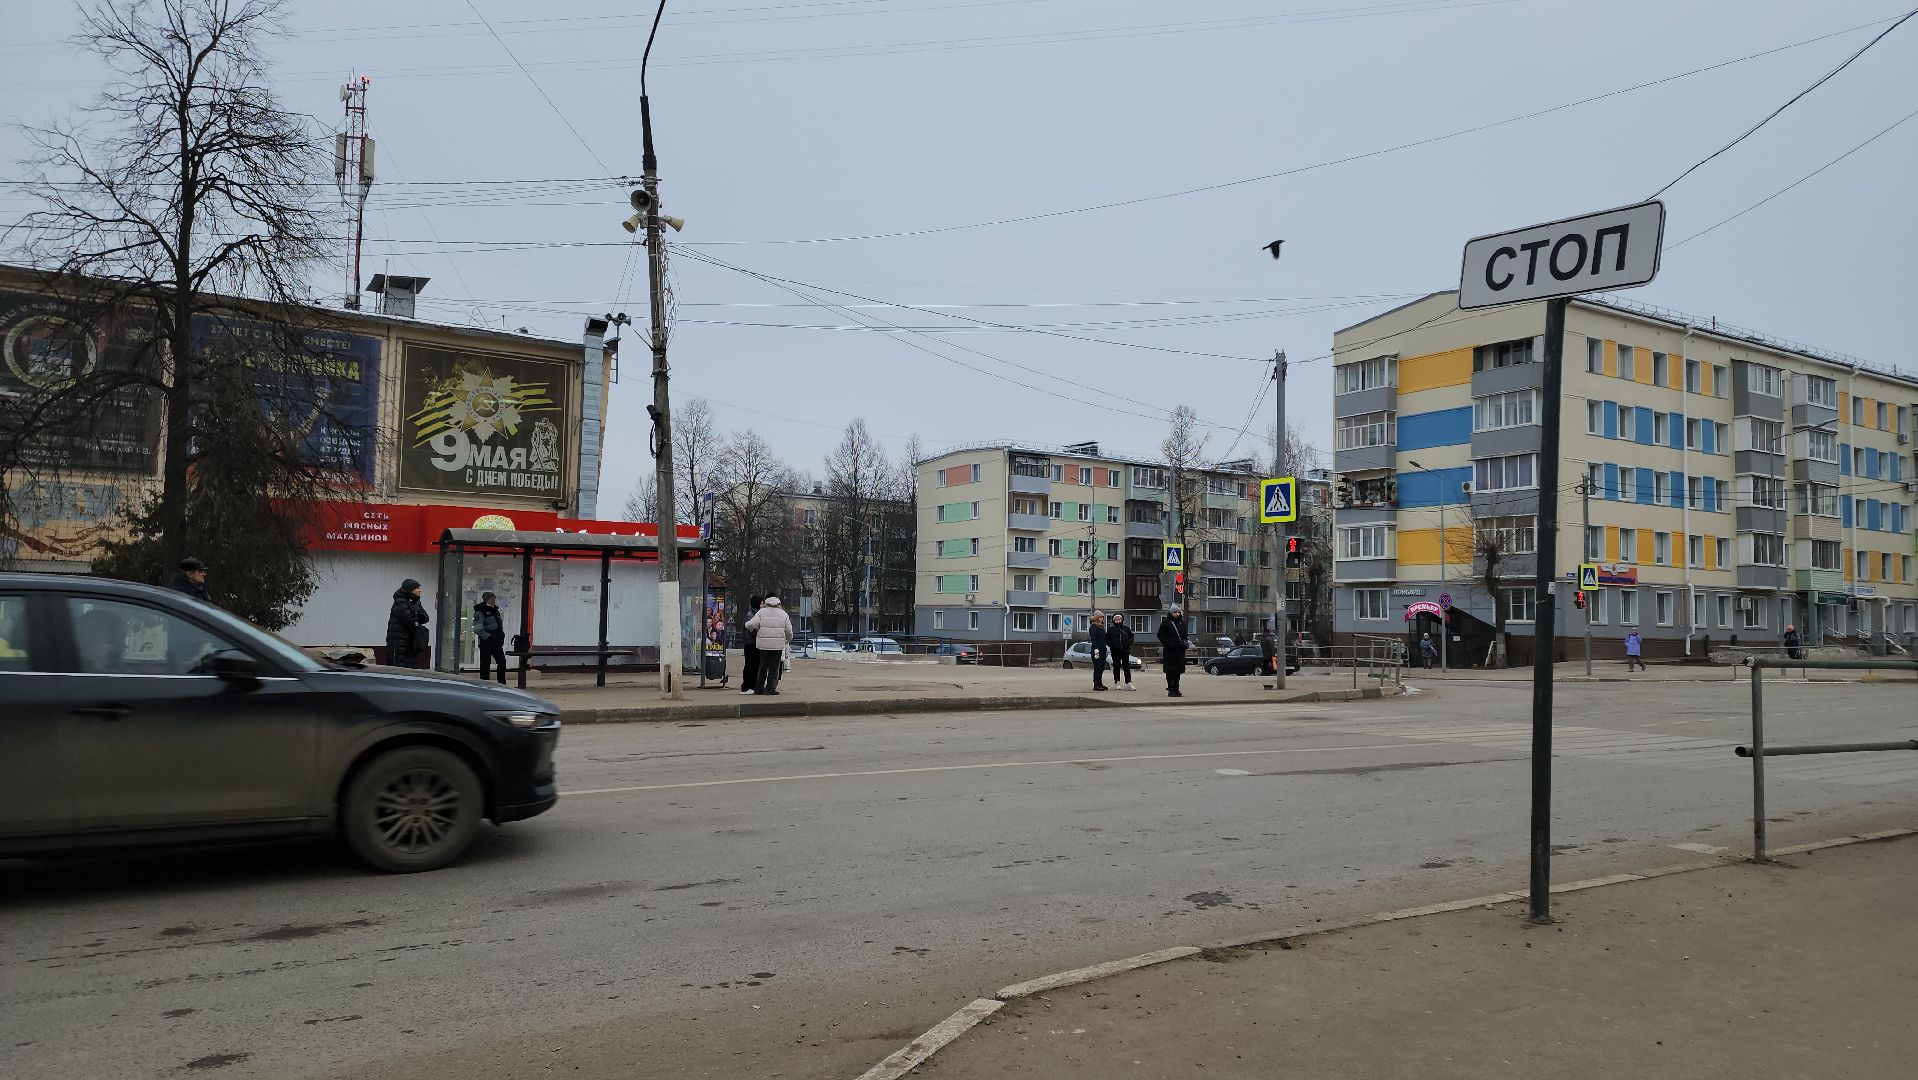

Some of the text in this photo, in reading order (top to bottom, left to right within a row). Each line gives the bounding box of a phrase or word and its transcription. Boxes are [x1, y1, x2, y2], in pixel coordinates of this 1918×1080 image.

[1485, 222, 1630, 292] СТОП
[430, 427, 527, 472] 9 МАЯ
[465, 469, 559, 491] С ДНЕМ ПОБЕДЫ!
[363, 511, 390, 520] СЕТЬ
[344, 521, 389, 531] МЯСНЫХ
[326, 532, 389, 542] МАГАЗИНОВ
